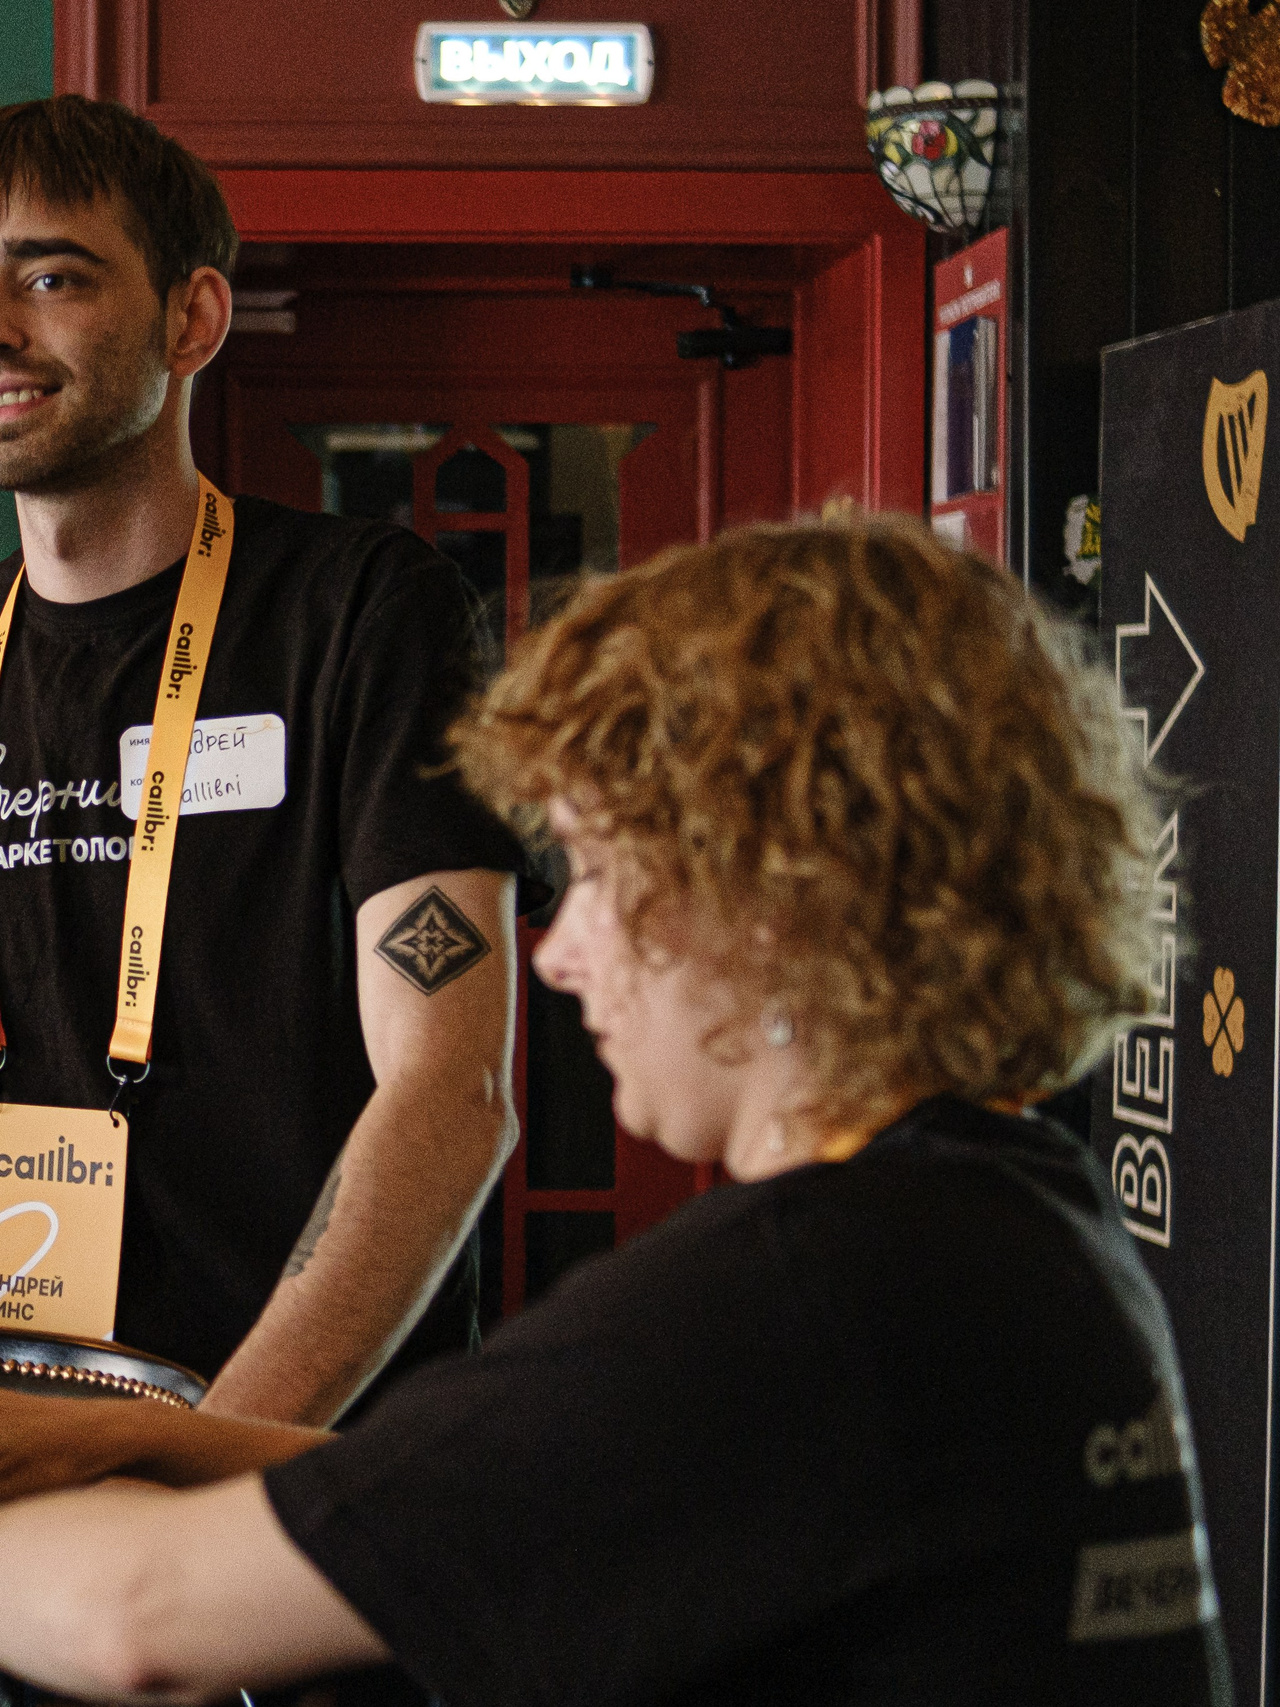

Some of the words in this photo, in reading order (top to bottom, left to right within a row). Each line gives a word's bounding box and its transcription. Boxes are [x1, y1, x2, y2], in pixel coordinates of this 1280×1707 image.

[439, 39, 632, 86] ВЫХОД
[166, 622, 198, 699] callibri
[142, 770, 170, 851] callibri
[125, 925, 150, 1007] callibri
